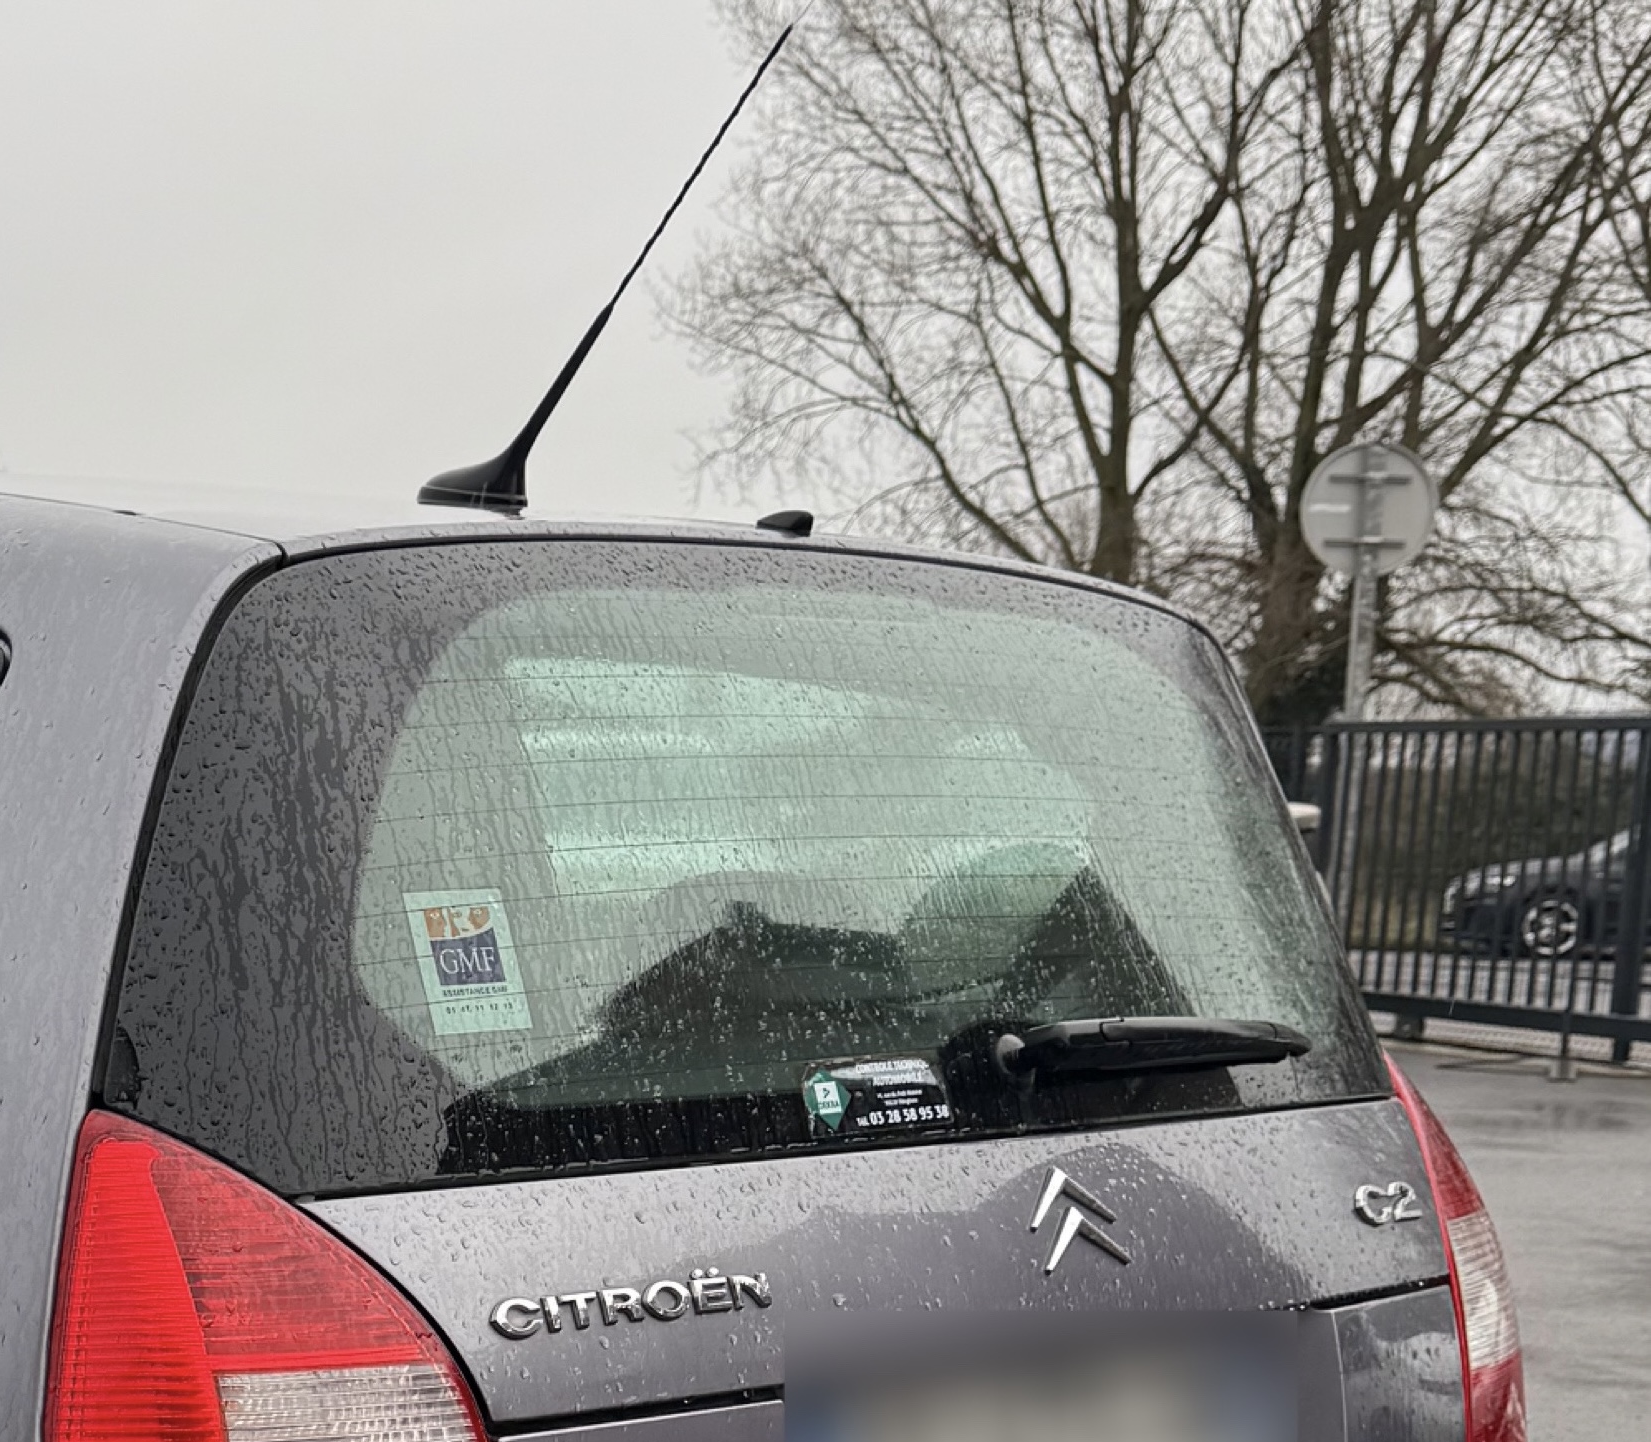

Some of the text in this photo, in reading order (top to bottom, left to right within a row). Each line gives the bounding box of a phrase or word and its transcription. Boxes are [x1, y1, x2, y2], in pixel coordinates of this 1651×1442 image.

[439, 946, 495, 974] GMF
[869, 1111, 884, 1125] 03
[886, 1109, 901, 1123] 28
[918, 1106, 933, 1120] 95
[1353, 1181, 1423, 1227] C2
[489, 1266, 772, 1340] CITROËN
